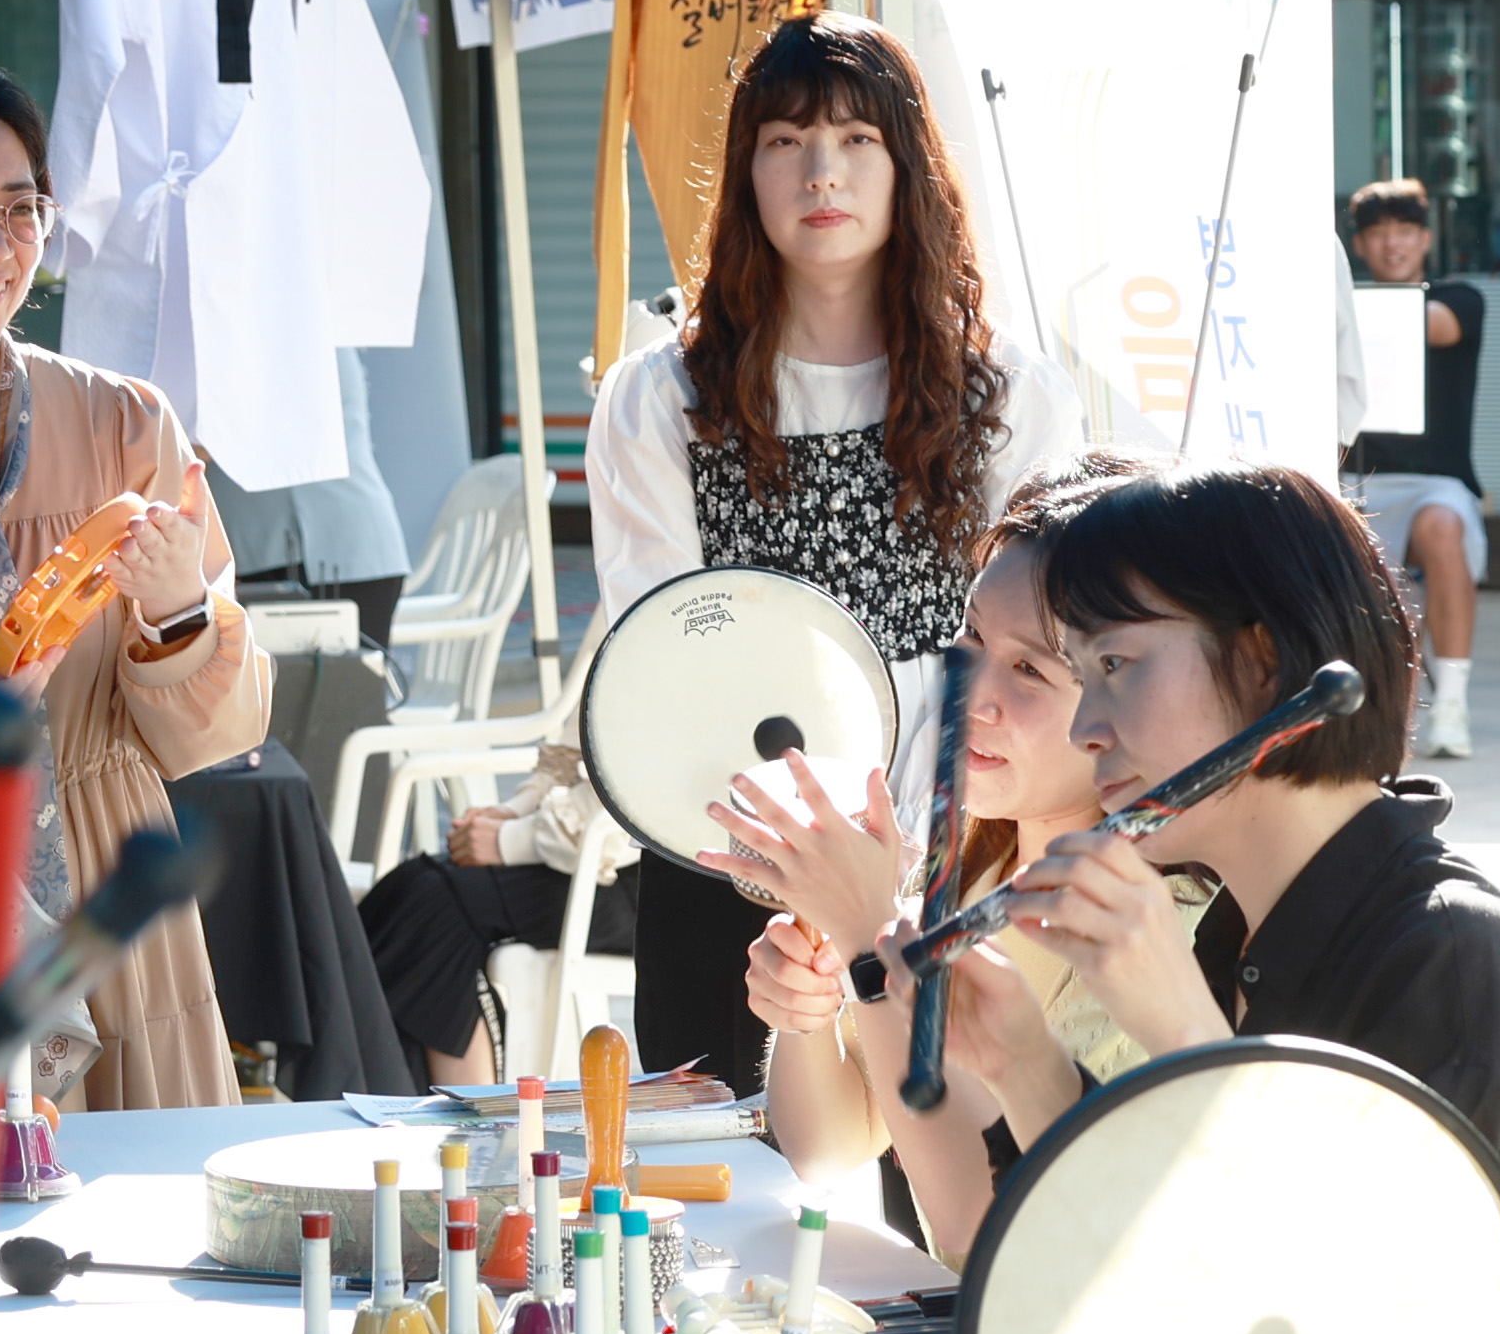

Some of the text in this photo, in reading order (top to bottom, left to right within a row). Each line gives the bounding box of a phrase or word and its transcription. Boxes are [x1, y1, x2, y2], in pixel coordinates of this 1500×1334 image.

[670, 592, 733, 617] Paddle Drums
[686, 601, 722, 618] Musical
[688, 612, 726, 628] REMO
